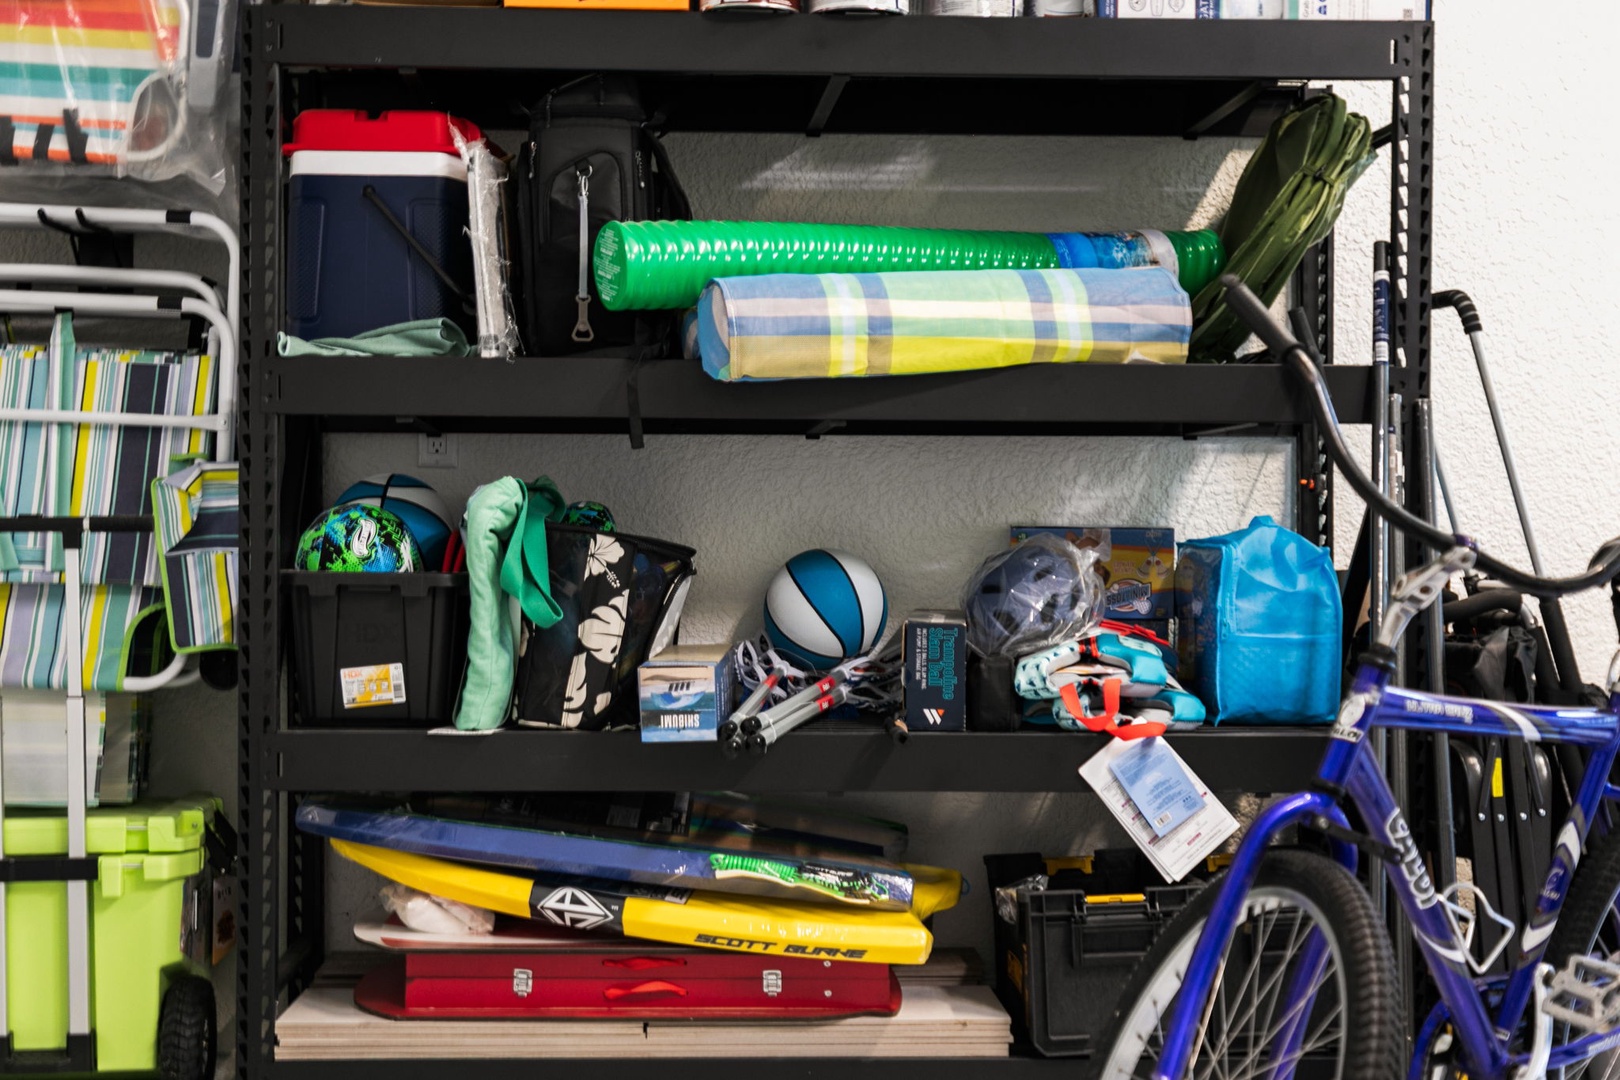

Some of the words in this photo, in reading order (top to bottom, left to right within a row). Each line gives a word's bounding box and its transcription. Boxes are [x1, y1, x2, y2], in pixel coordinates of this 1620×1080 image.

[929, 628, 943, 659] Slam
[928, 661, 943, 686] Ball
[941, 628, 958, 700] Trampoline
[660, 713, 700, 729] SHIBUMI
[694, 933, 777, 950] SCOTT
[783, 943, 868, 959] BURKE
